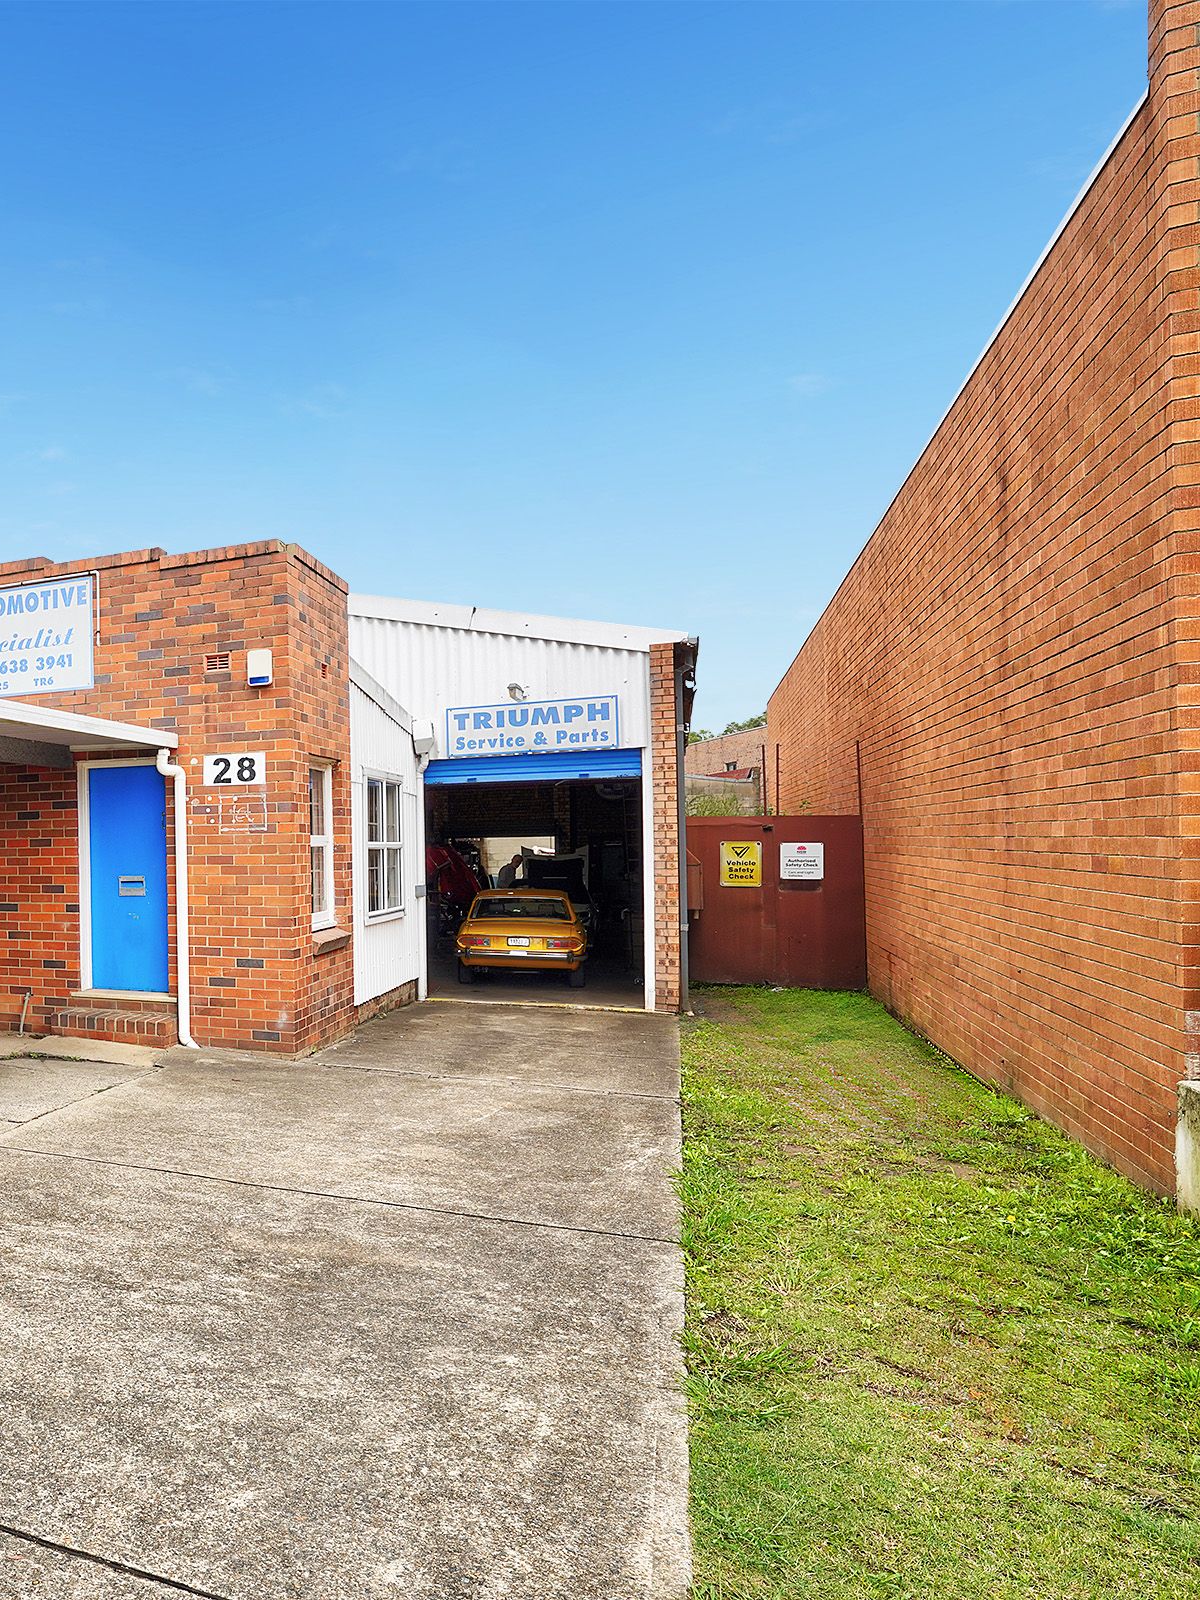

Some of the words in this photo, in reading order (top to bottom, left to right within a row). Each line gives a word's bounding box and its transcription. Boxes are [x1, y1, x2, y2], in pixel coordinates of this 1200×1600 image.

[36, 653, 73, 671] 3941
[33, 677, 54, 686] TR6
[454, 702, 610, 731] TRIUMPH
[456, 733, 525, 750] Service
[534, 731, 548, 746] &
[556, 728, 609, 744] Parts
[212, 757, 256, 784] 28
